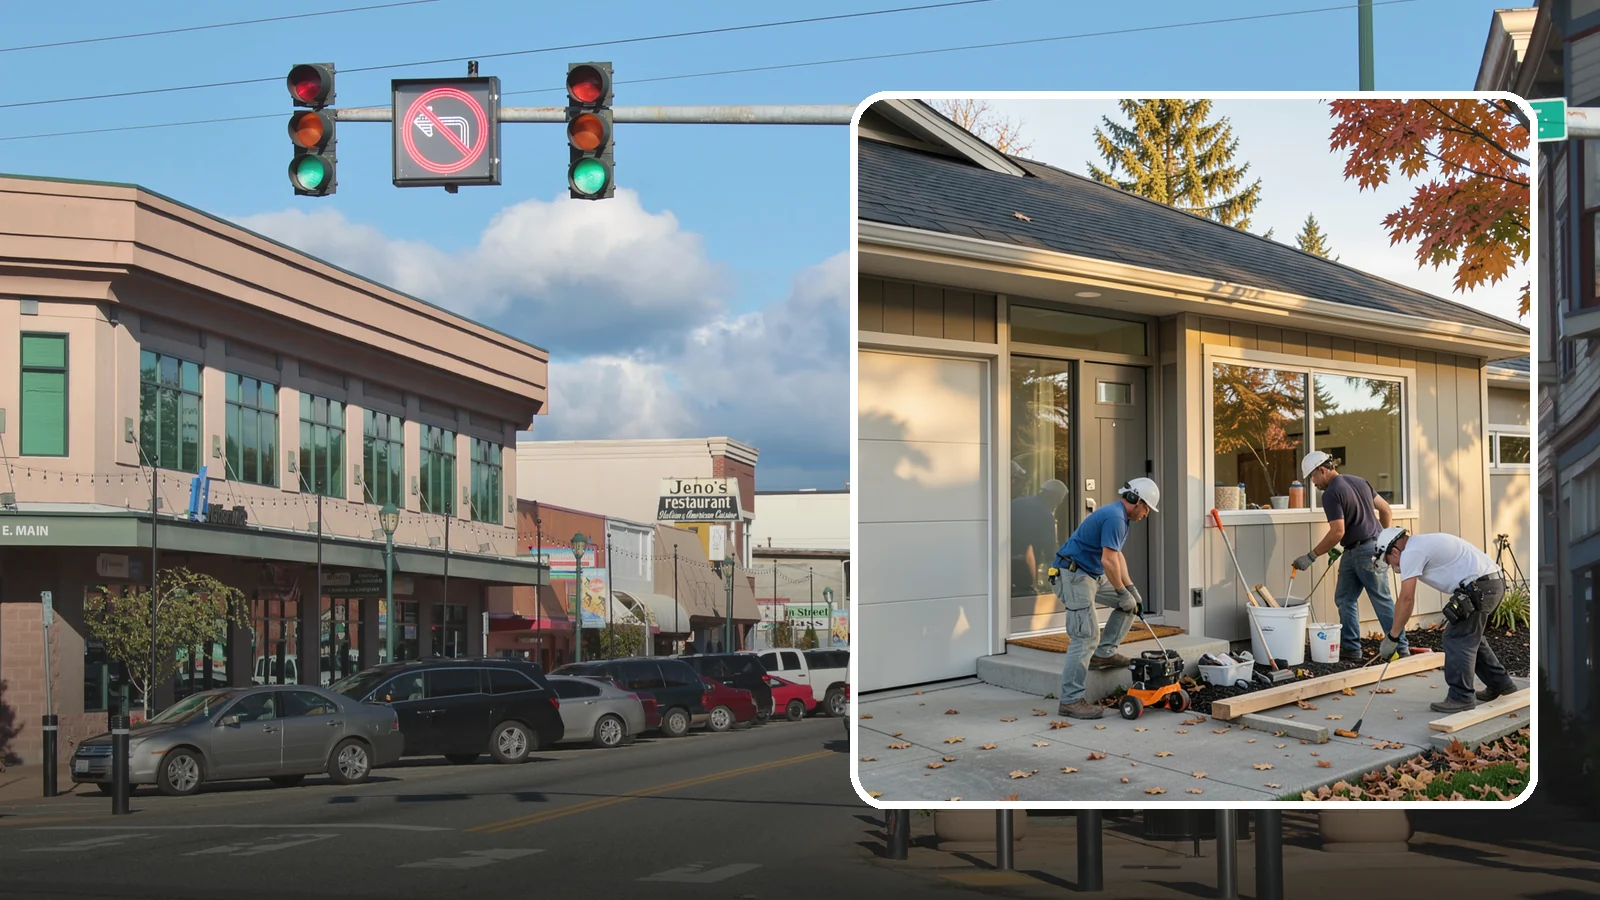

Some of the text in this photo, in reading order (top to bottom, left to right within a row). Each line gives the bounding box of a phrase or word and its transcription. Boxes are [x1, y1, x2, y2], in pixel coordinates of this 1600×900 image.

[670, 480, 728, 494] Jeno's
[665, 497, 731, 509] restaurant
[686, 509, 714, 519] American
[715, 509, 737, 519] Cuisine
[2, 525, 49, 536] E. MAIN
[797, 607, 829, 617] Street
